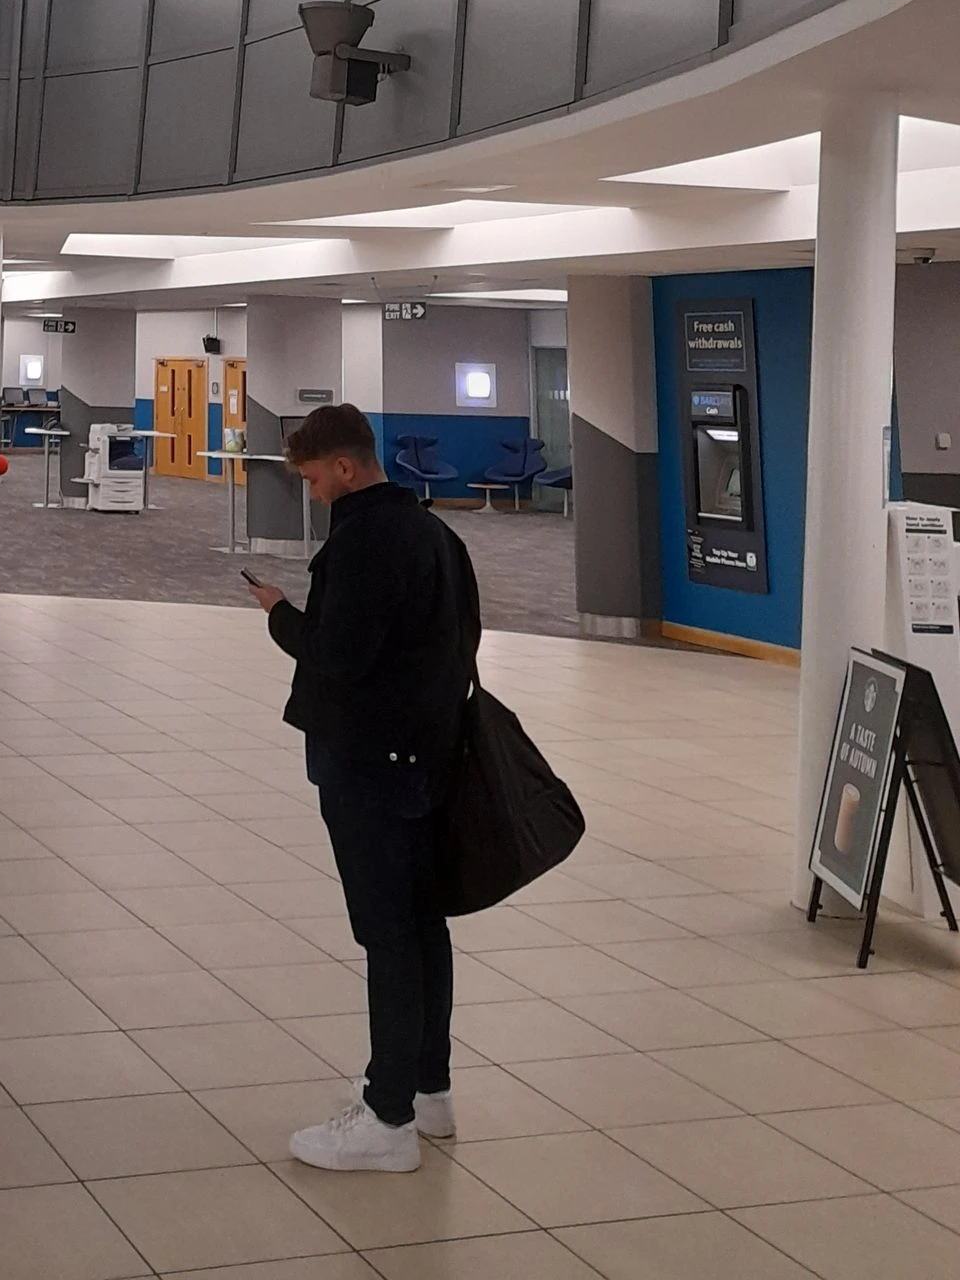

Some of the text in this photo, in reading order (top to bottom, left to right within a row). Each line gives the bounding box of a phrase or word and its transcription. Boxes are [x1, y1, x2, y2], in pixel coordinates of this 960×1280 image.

[385, 303, 400, 311] FIRE
[385, 311, 400, 320] EXIT
[693, 320, 735, 332] Free cash
[688, 337, 743, 349] withdrawals
[849, 722, 877, 753] A TASTE
[840, 741, 878, 780] OF AUTUMN
